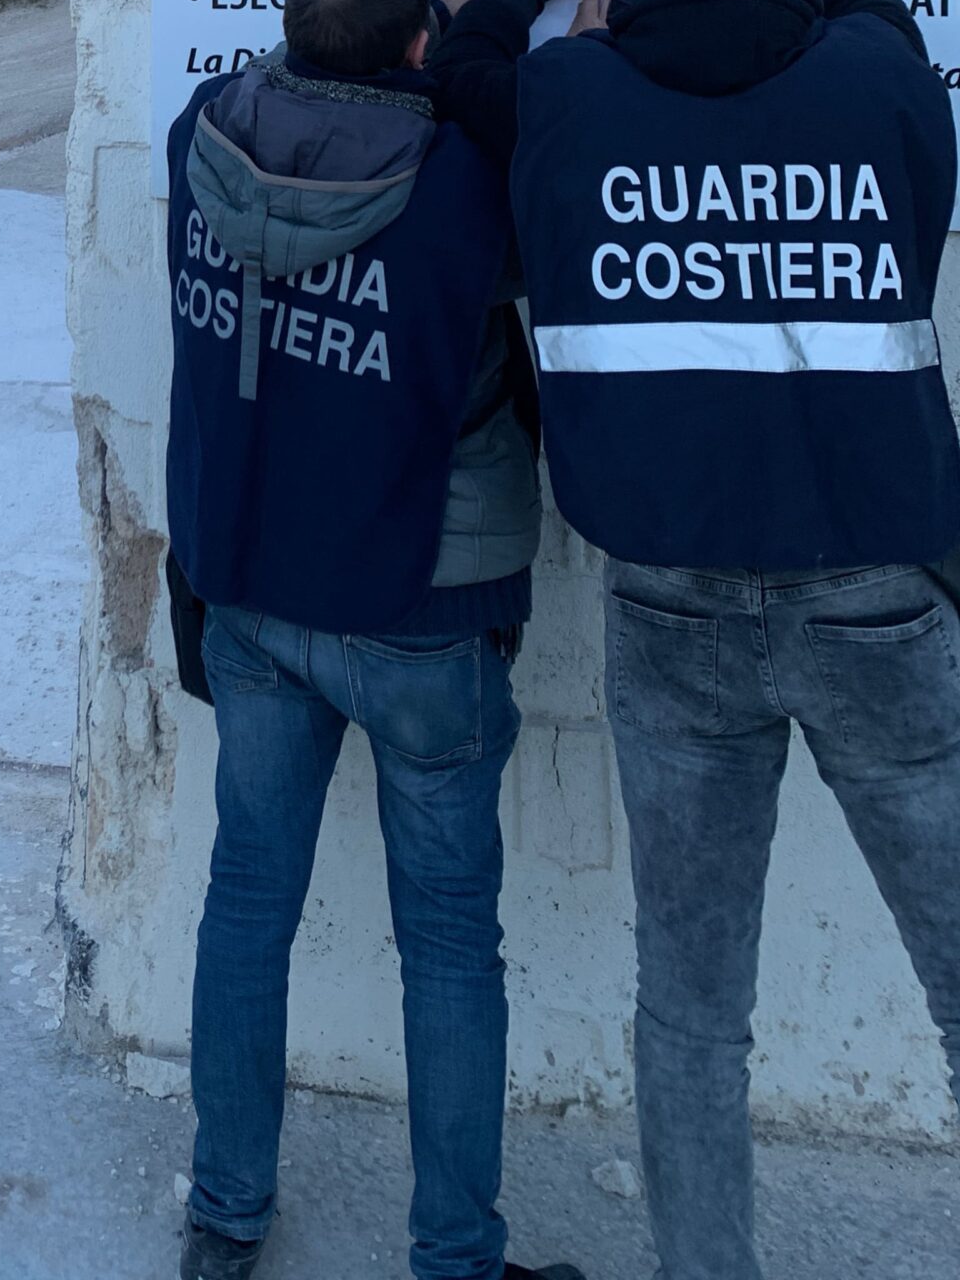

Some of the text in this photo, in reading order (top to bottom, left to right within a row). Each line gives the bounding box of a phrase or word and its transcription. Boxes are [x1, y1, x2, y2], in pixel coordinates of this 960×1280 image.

[186, 48, 223, 74] La
[601, 163, 888, 223] GUARDIA
[591, 241, 903, 300] COSTIERA
